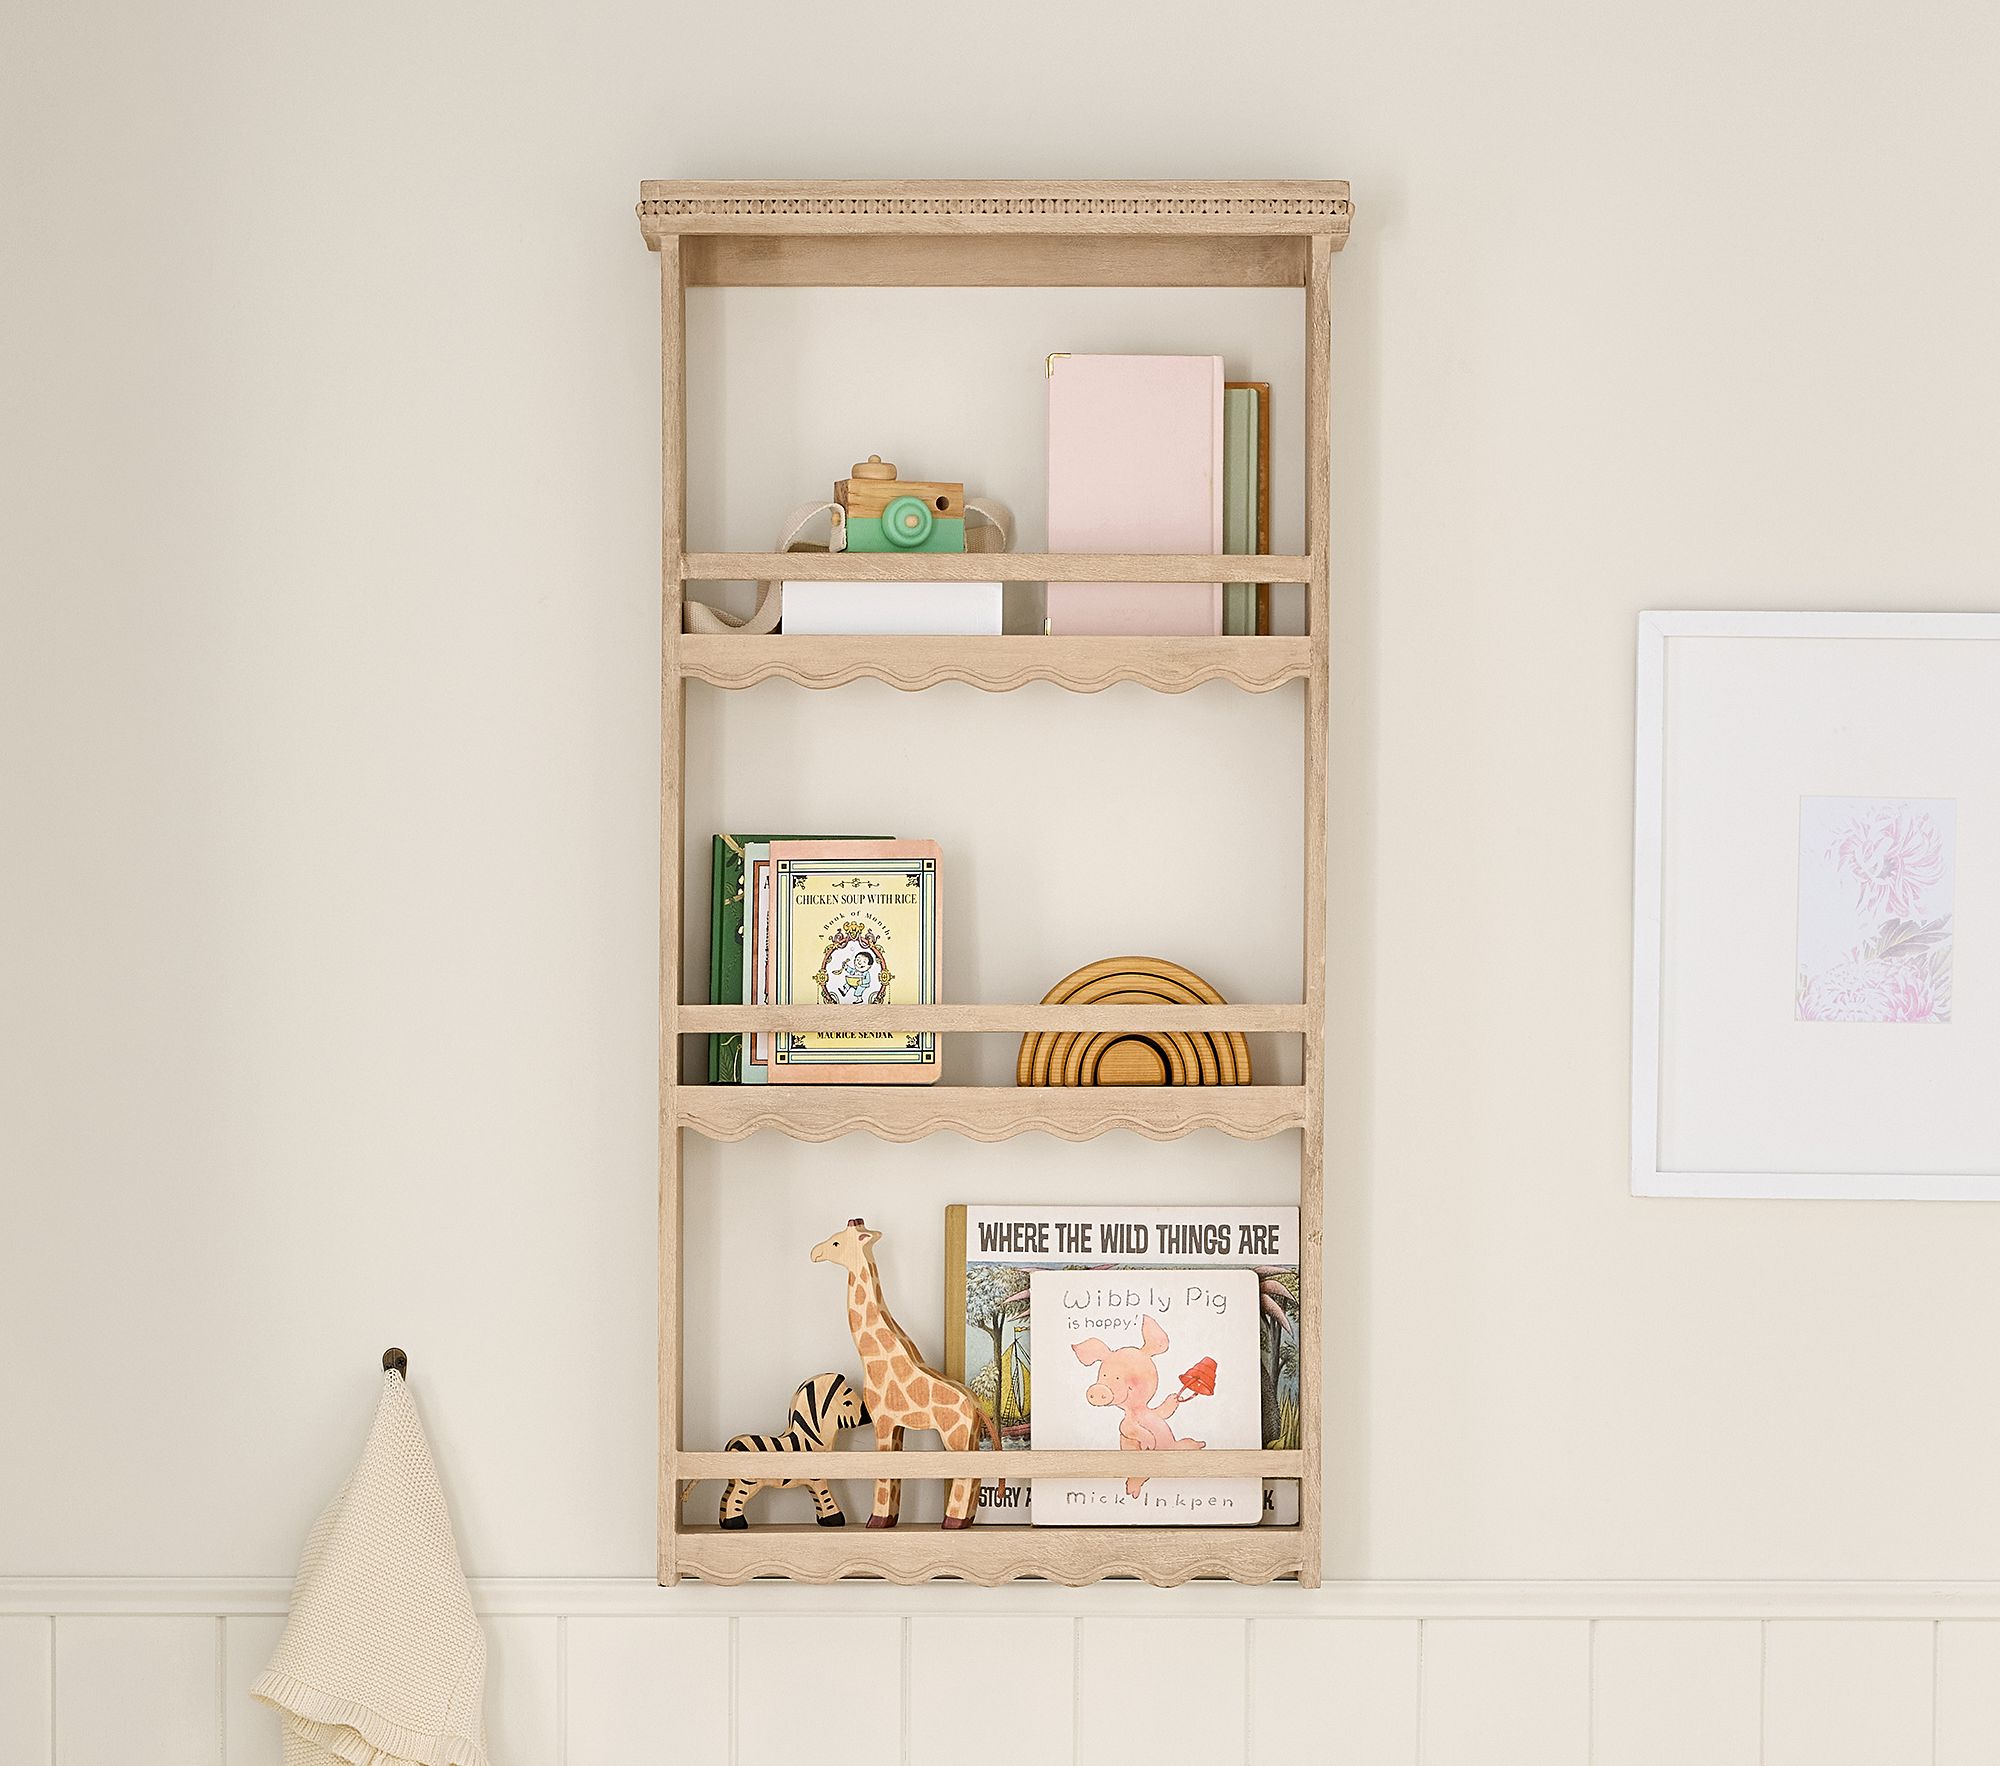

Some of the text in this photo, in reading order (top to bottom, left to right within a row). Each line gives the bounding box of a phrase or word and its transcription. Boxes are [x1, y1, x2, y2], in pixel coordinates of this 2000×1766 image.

[796, 894, 917, 905] CHICKEN SOUP WITH RICE
[823, 913, 845, 931] Book
[865, 912, 892, 941] Months
[817, 1031, 894, 1039] MAURICE SENDAK
[978, 1222, 1280, 1255] WHERE THE WILD THINGS ARE
[1063, 1287, 1227, 1314] Wibbly Pig
[1068, 1314, 1139, 1330] is happy!
[979, 1486, 1021, 1507] STORY
[1144, 1492, 1234, 1511] Inkpen
